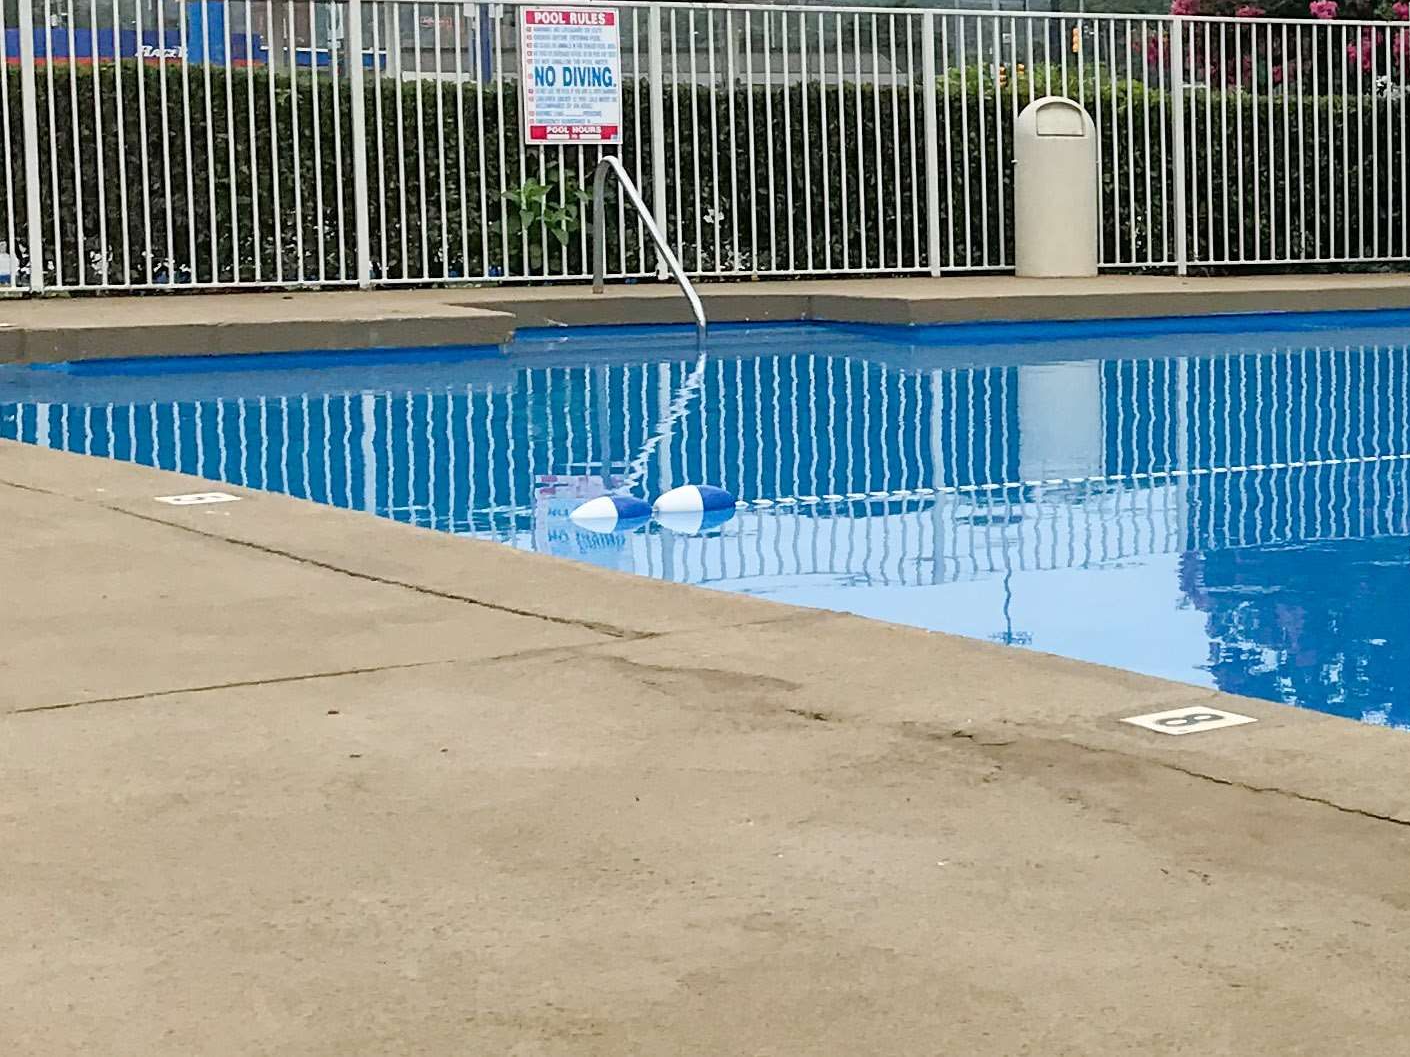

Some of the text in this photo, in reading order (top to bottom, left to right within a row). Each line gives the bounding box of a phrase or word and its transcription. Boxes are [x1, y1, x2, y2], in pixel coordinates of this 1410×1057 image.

[534, 11, 606, 25] POOL RULES
[534, 65, 556, 87] NO
[546, 126, 602, 134] POOL HOURS
[1155, 712, 1225, 728] 8
